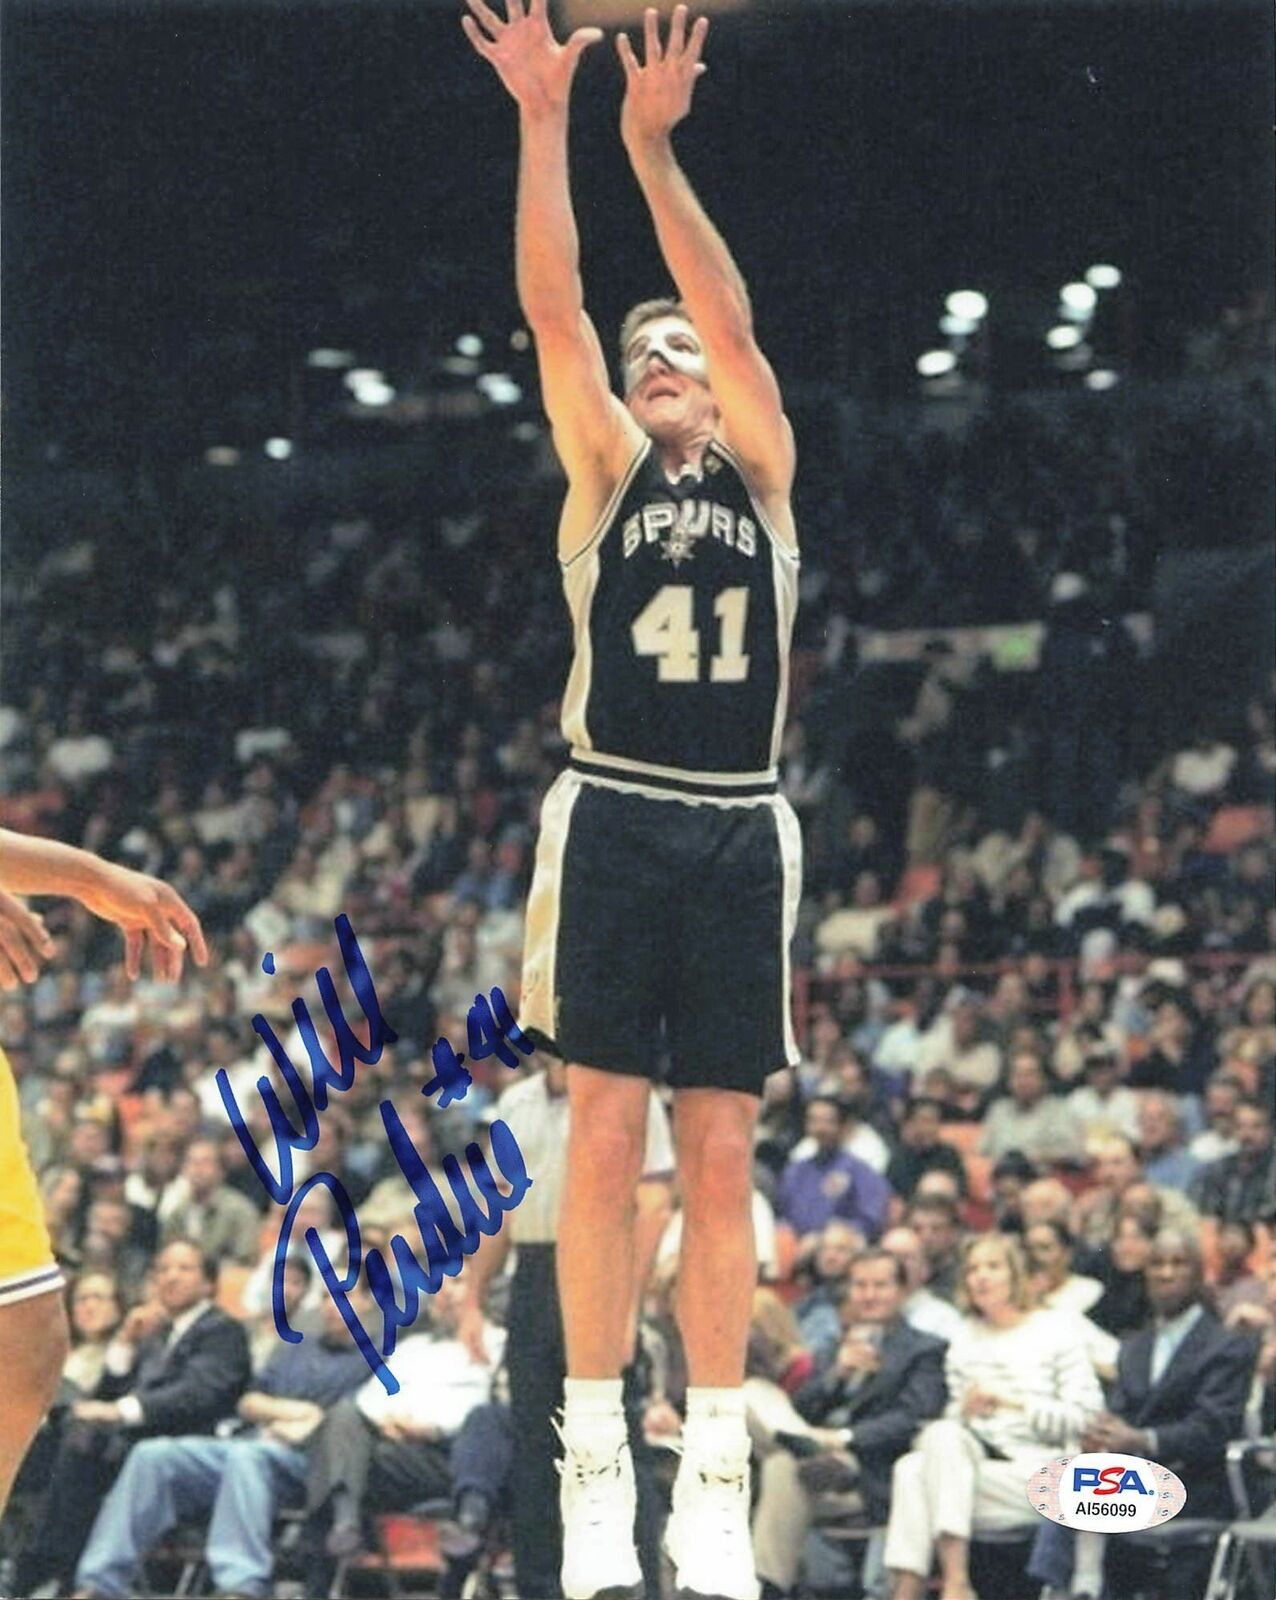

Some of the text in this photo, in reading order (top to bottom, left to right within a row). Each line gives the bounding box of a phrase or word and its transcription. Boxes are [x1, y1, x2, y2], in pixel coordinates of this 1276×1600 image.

[622, 499, 757, 559] SPURS
[631, 585, 750, 682] 41
[215, 913, 398, 1205] Will
[1073, 1467, 1148, 1495] PSA
[1075, 1502, 1137, 1517] AI56099
